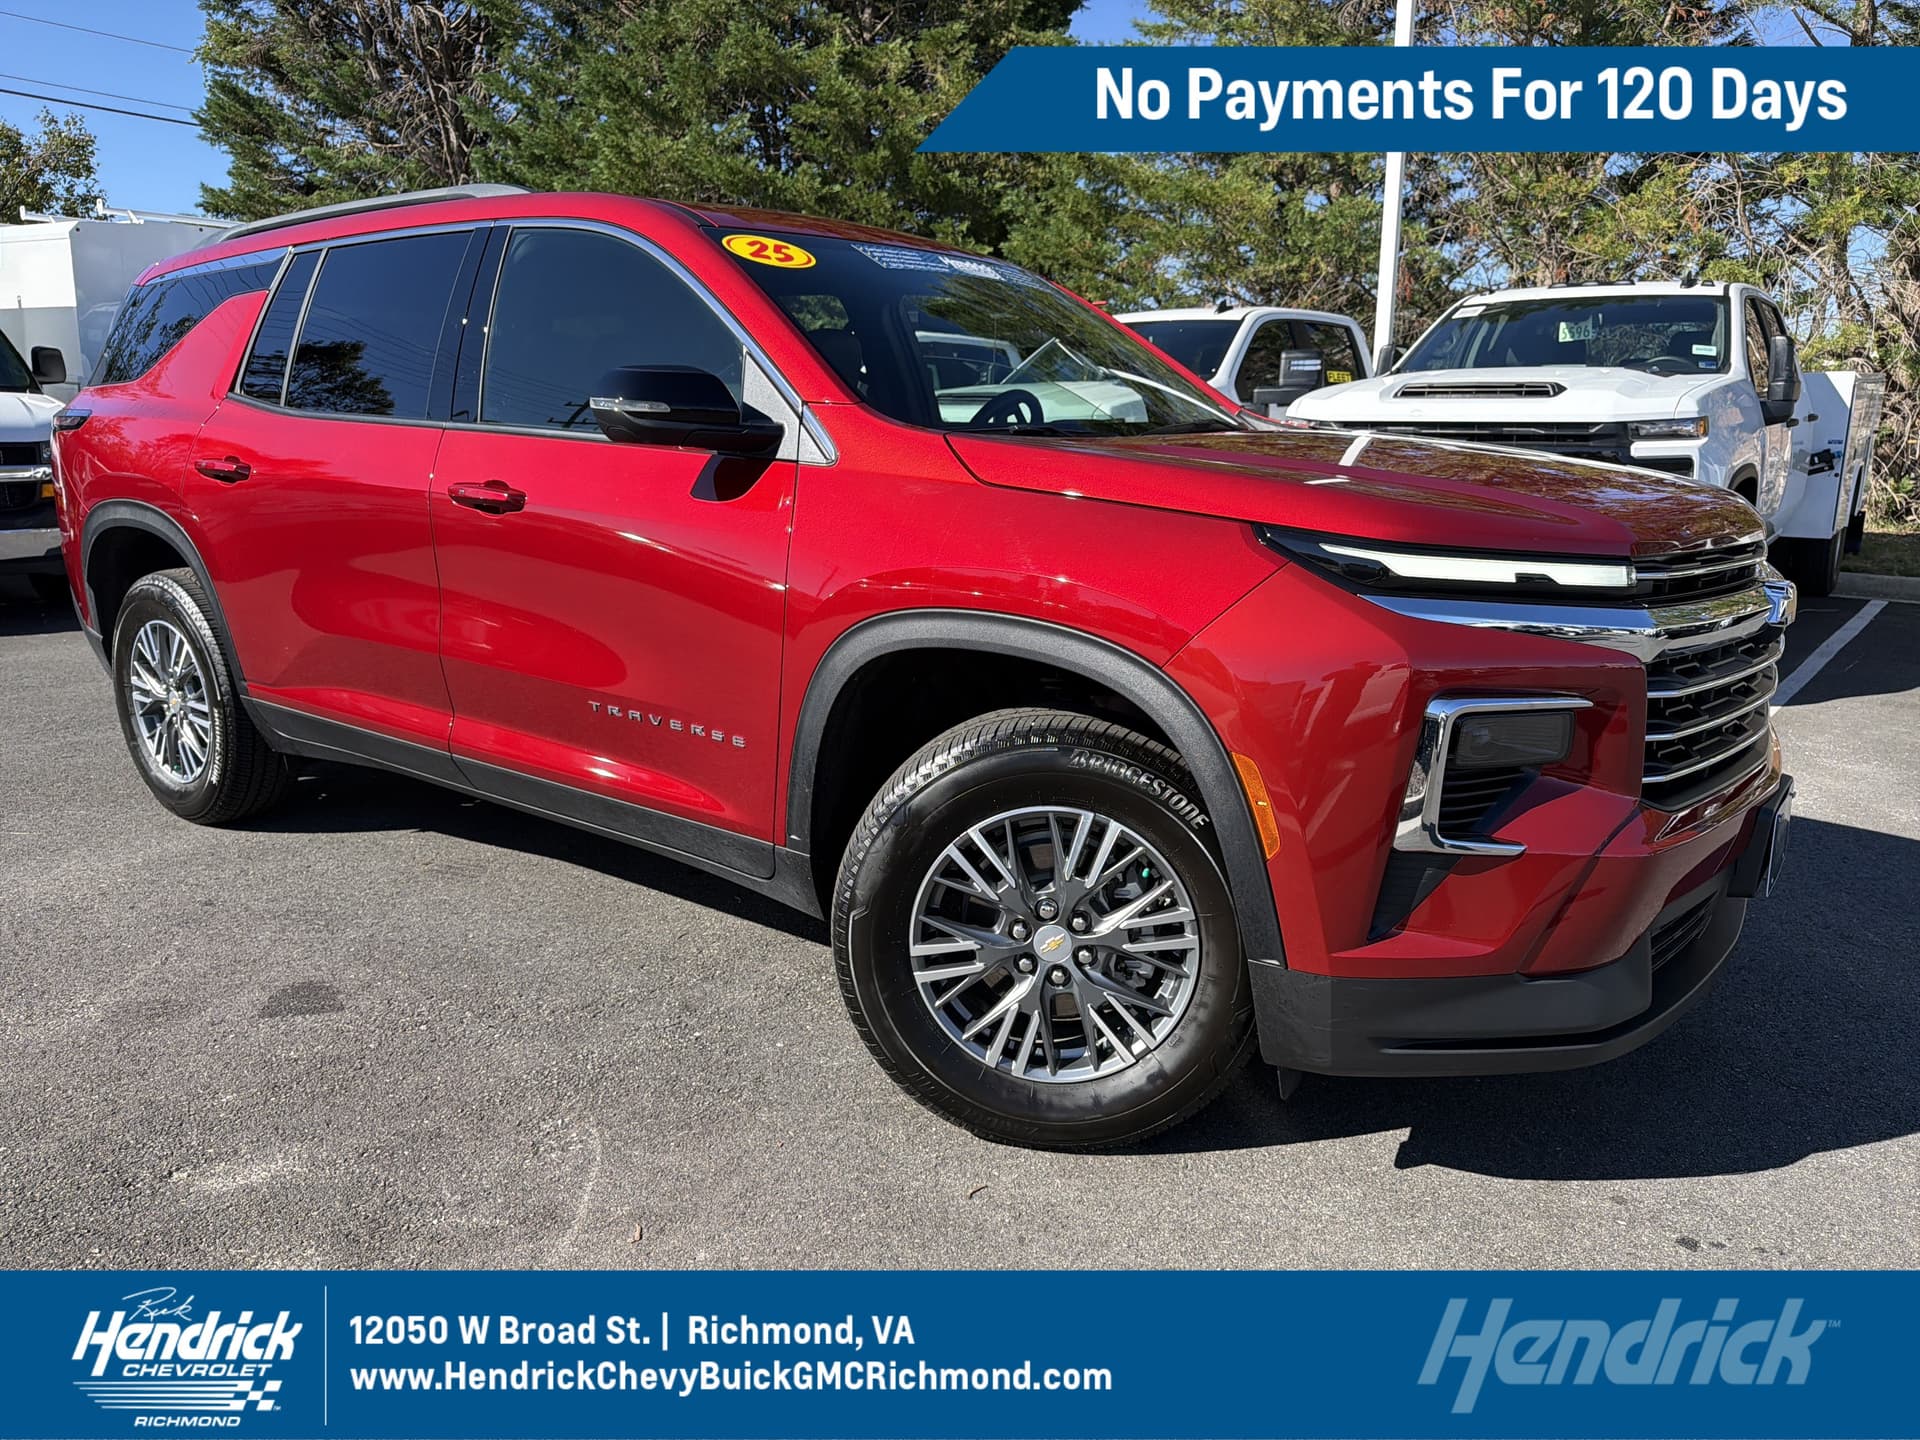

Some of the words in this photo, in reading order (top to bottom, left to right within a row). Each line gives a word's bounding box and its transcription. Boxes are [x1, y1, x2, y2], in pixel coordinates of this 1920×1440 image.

[745, 240, 795, 262] 25
[588, 700, 746, 748] TRAVERSE
[1068, 748, 1210, 829] BRIDGESTONE
